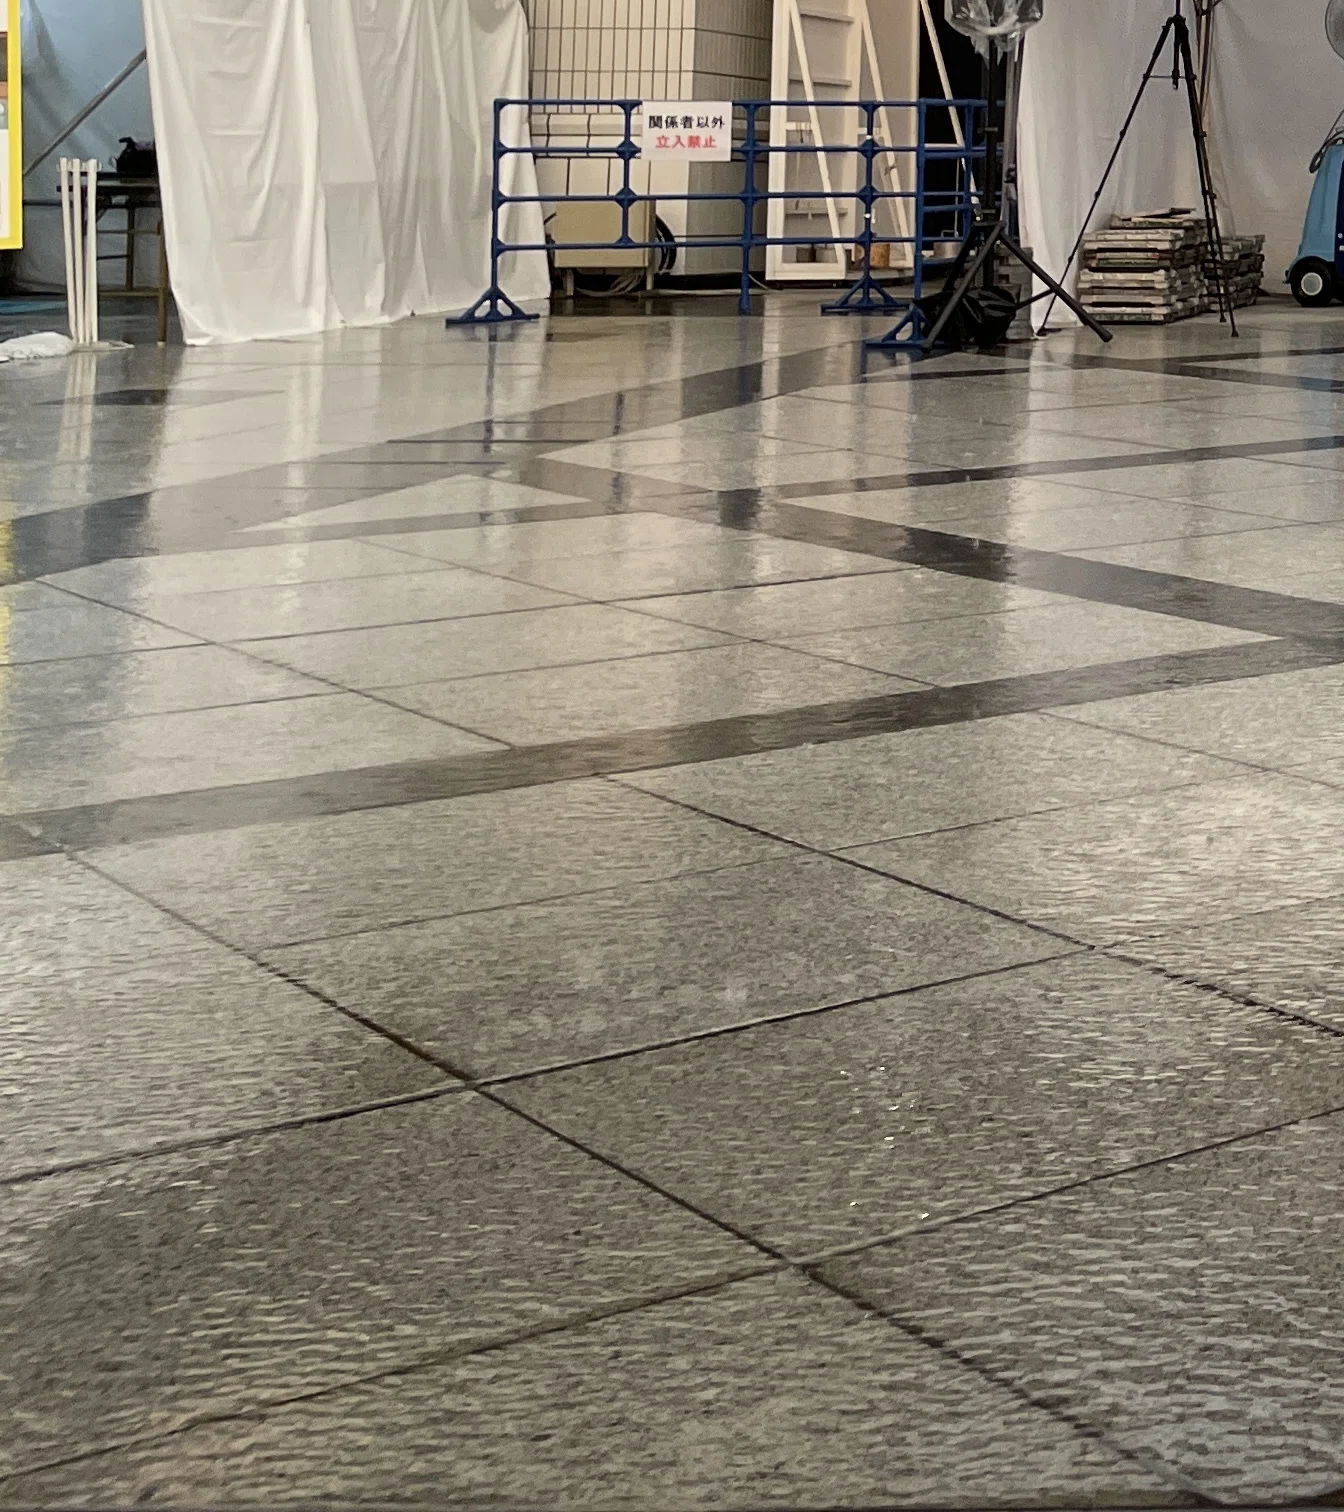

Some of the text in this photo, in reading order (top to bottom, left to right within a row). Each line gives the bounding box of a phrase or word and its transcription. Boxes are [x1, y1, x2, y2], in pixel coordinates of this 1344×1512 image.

[649, 115, 725, 129] 関係者以外
[655, 135, 717, 149] 立入禁止
